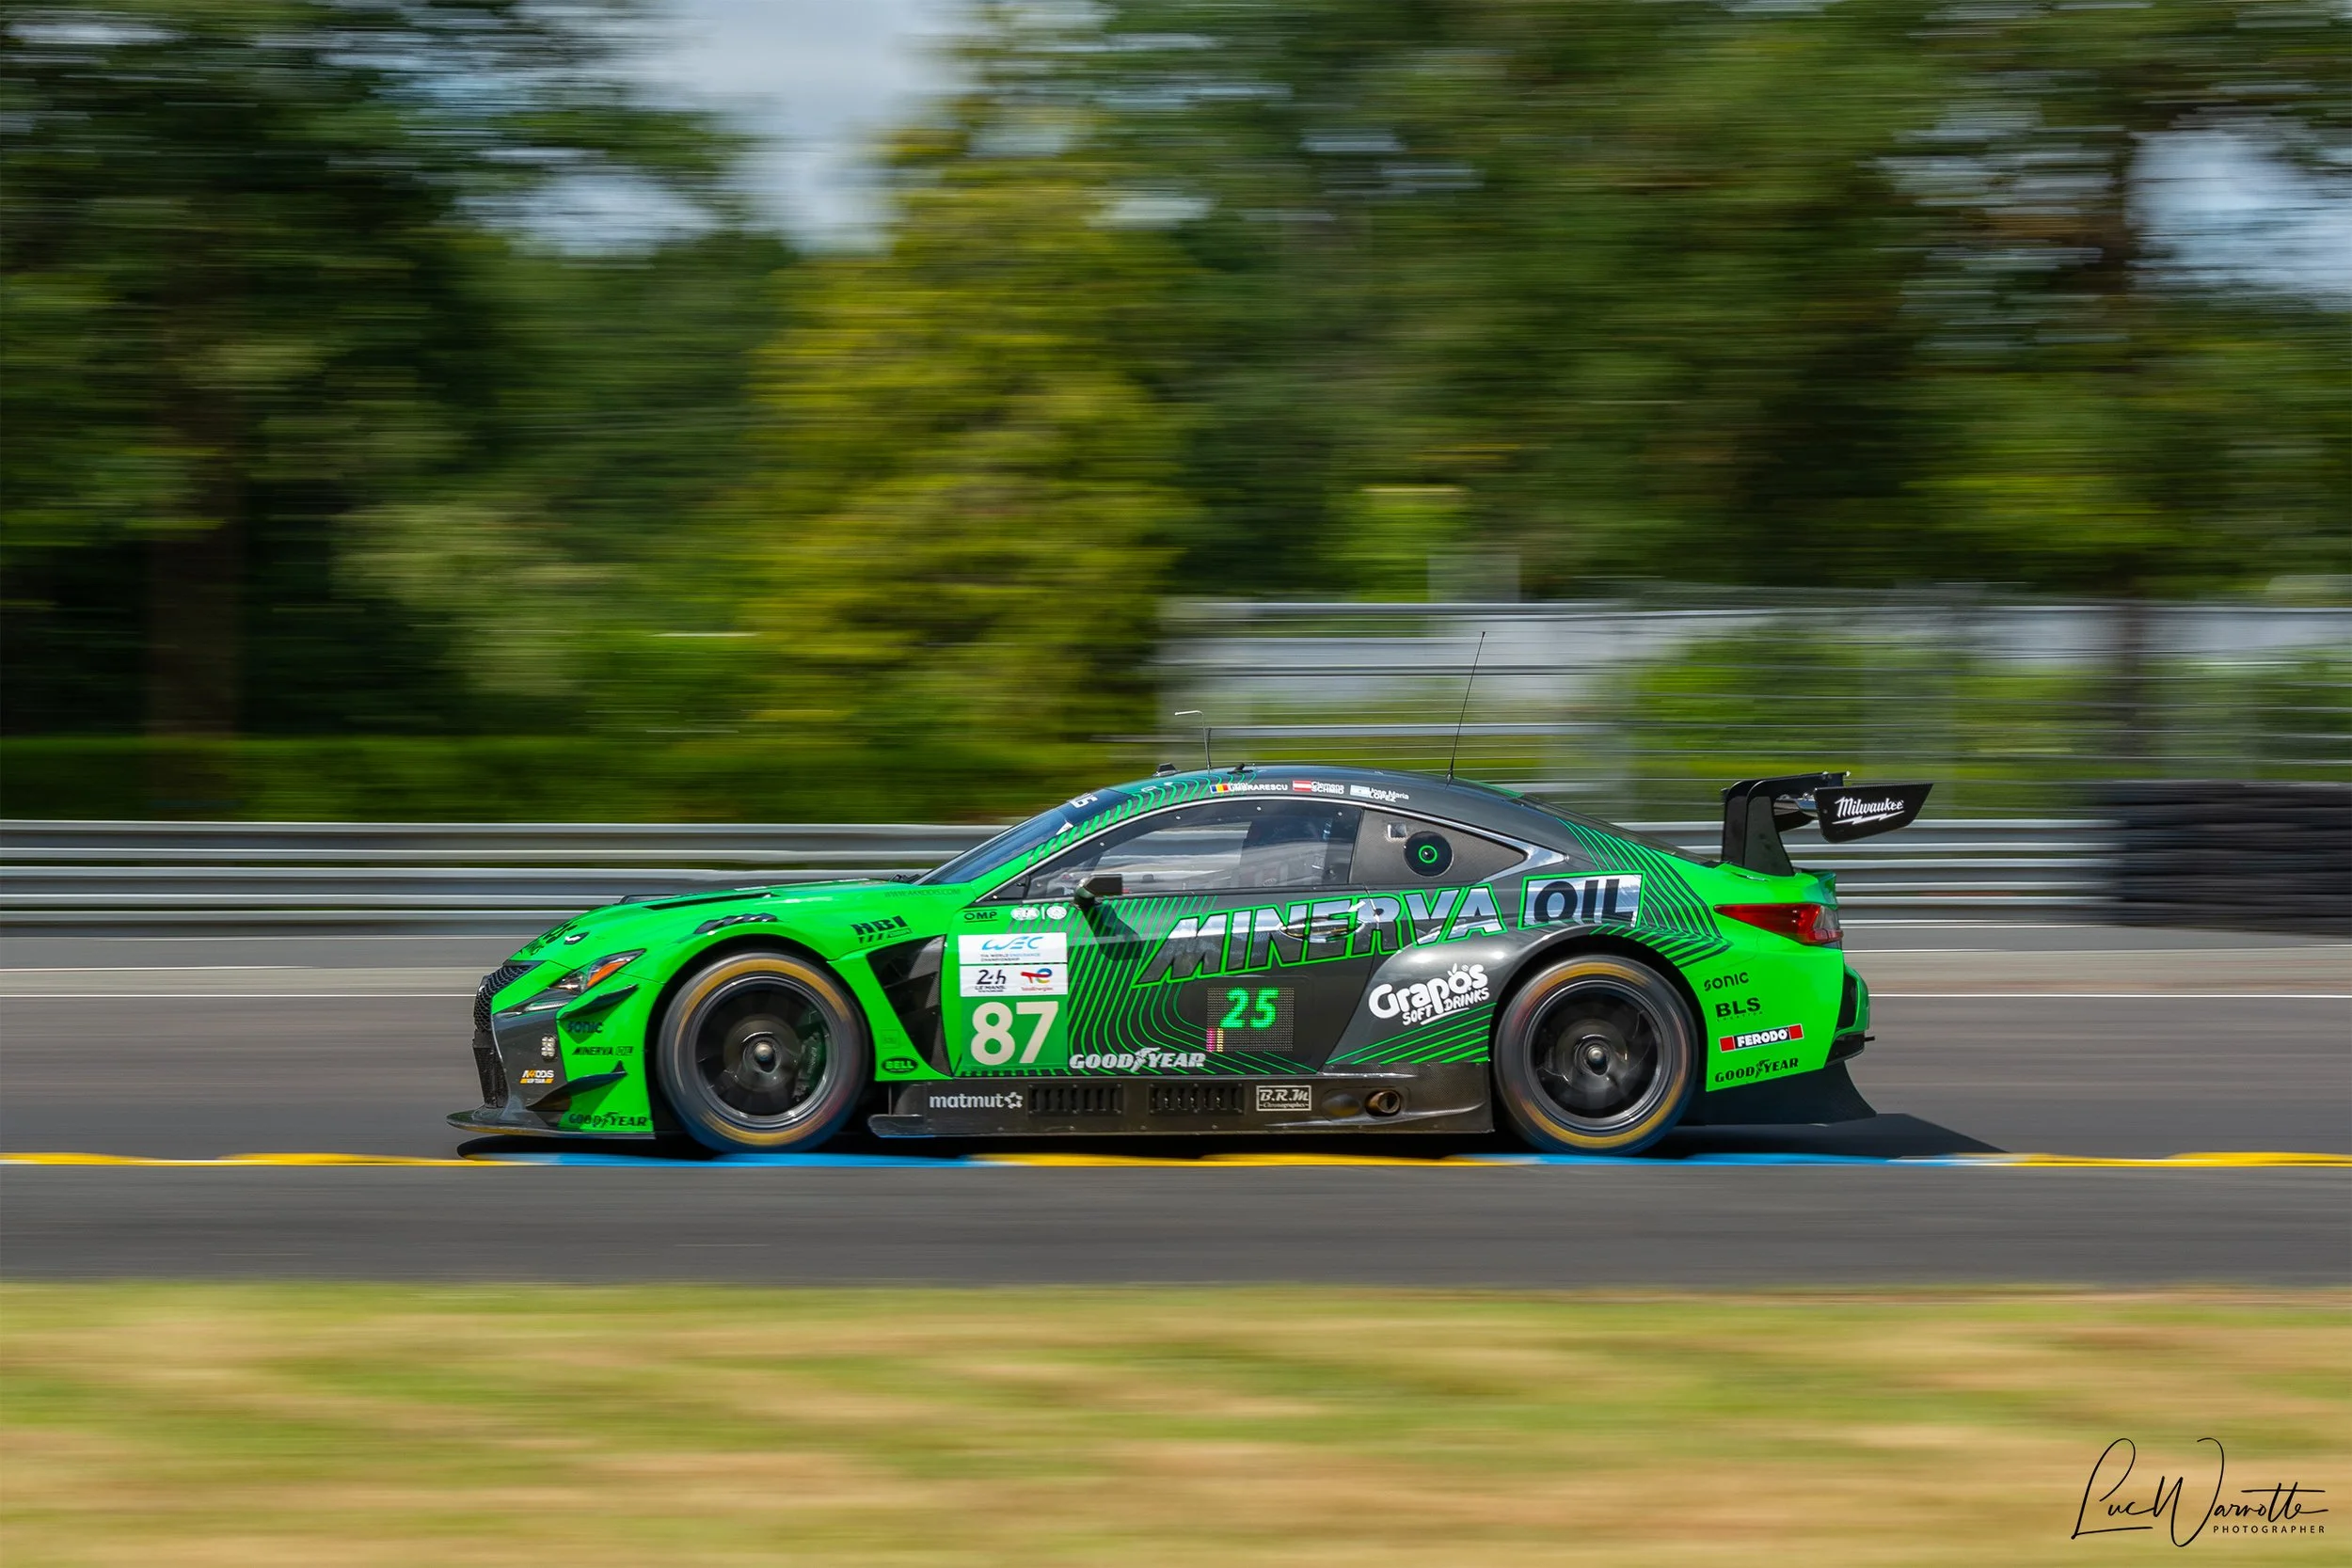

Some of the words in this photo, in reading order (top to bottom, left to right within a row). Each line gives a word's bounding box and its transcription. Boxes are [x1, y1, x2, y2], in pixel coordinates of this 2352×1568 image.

[1835, 796, 1904, 817] Milwaukee
[851, 915, 909, 935] HBI
[964, 911, 997, 921] OMP
[981, 936, 1043, 951] WEC
[1132, 883, 1507, 989] MINERVA
[1534, 878, 1637, 927] OIL
[1219, 987, 1279, 1029] 25
[1402, 1005, 1433, 1026] SOFT
[1443, 988, 1490, 1012] DRINKS
[1715, 997, 1761, 1018] BLS
[971, 1001, 1059, 1066] 87
[1737, 1029, 1788, 1047] FERODO
[885, 1060, 914, 1069] BELL
[1070, 1048, 1206, 1072] GOODYEAR
[1715, 1057, 1799, 1083] GOODYEAR
[930, 1093, 1005, 1109] matmut
[568, 1112, 647, 1127] GOODYEAR
